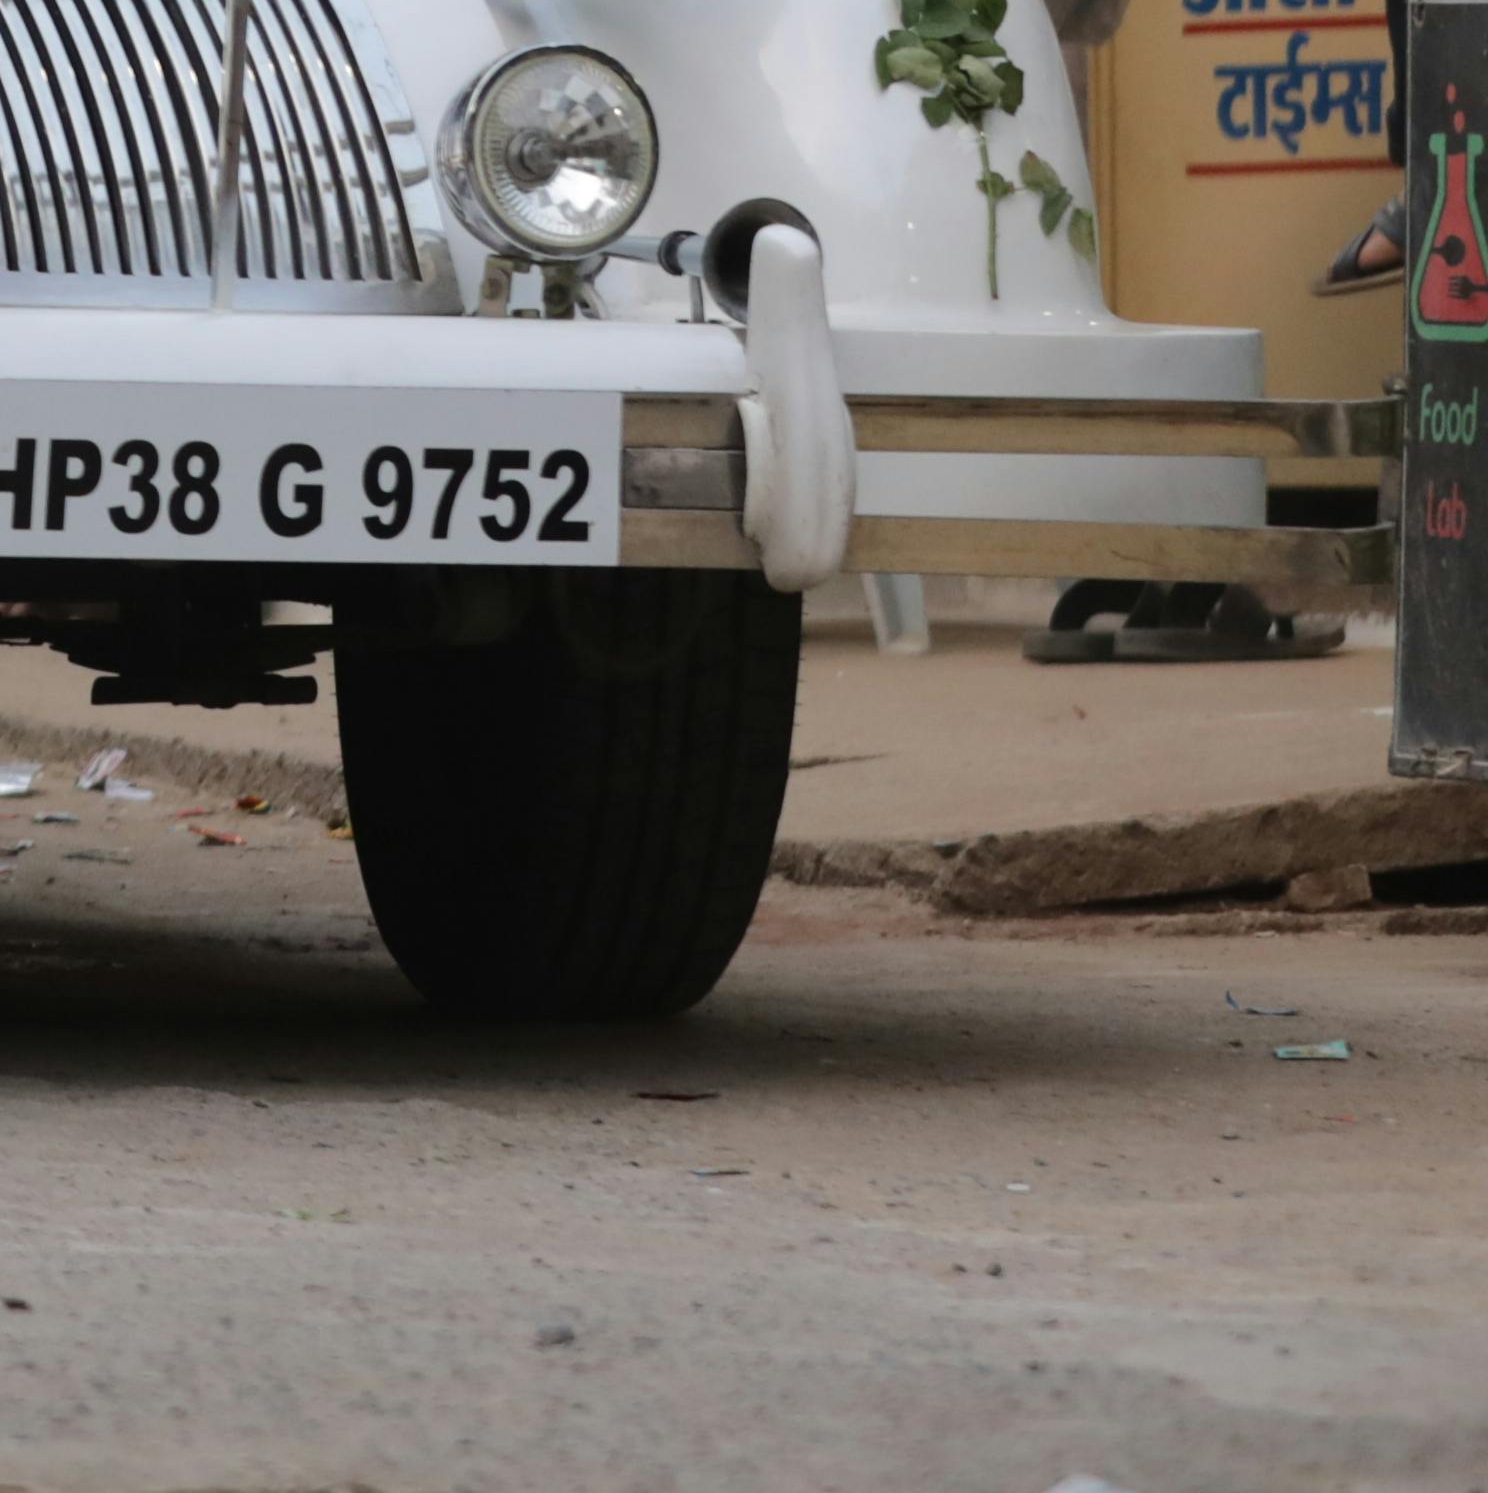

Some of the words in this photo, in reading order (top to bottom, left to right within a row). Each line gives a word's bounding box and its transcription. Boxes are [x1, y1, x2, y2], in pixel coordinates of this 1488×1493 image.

[1214, 30, 1388, 155] टाईम्स
[259, 442, 324, 538] G
[361, 444, 592, 543] 9752
